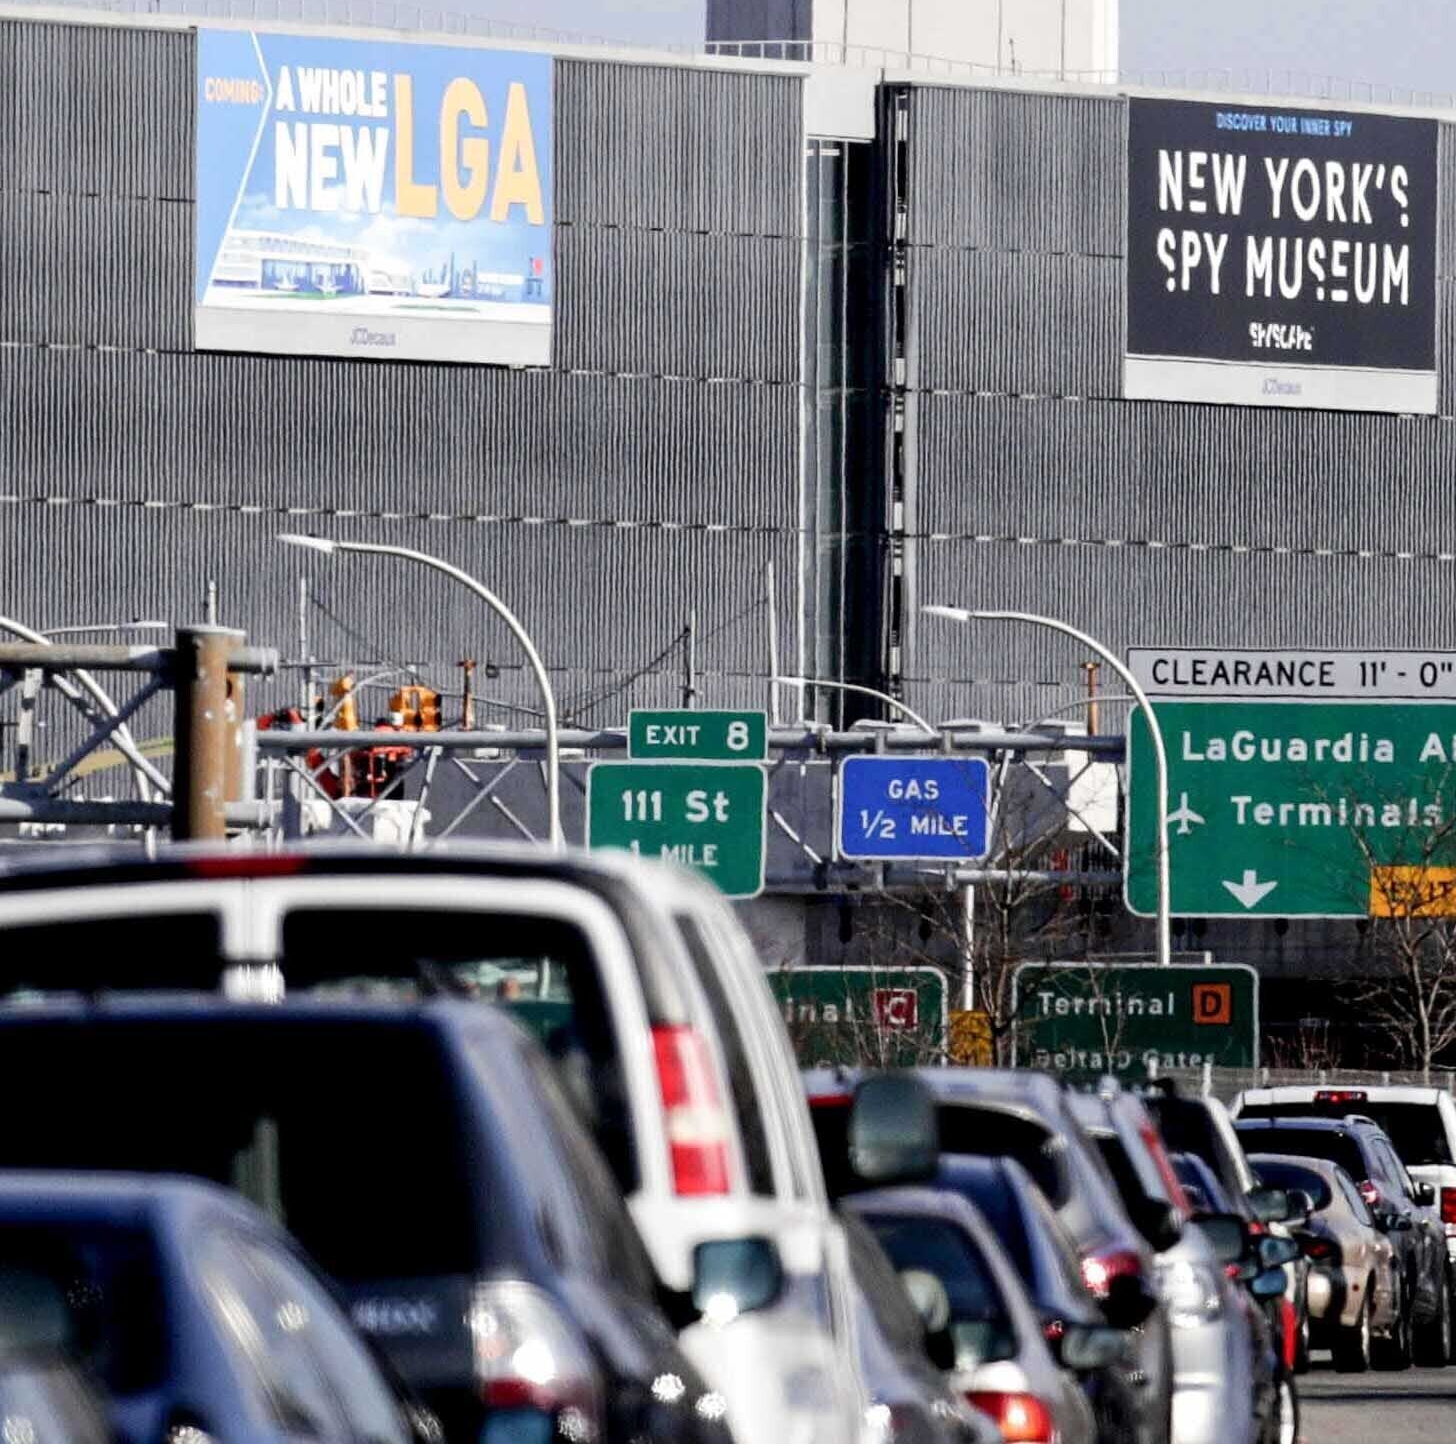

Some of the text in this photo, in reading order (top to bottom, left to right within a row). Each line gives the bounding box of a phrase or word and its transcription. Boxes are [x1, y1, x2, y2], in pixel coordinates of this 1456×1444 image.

[275, 65, 388, 117] A WHOLE
[1216, 112, 1353, 137] DISCOVER YOUR INNER SPY
[393, 72, 545, 226] LGA
[274, 121, 389, 214] NEW
[1157, 148, 1410, 228] NEW YORK'S
[1156, 227, 1411, 306] SPY MUSEUM
[1151, 659, 1335, 688] CLEARANCE
[646, 720, 750, 751] EXIT 8
[1182, 730, 1395, 763] LaGuardia
[887, 779, 940, 801] GAS
[622, 789, 730, 823] 111 St
[1230, 795, 1444, 827] Terminals
[909, 814, 969, 837] MILE
[661, 843, 718, 866] MILE
[785, 996, 909, 1024] inal C
[1037, 991, 1223, 1018] Terminal D
